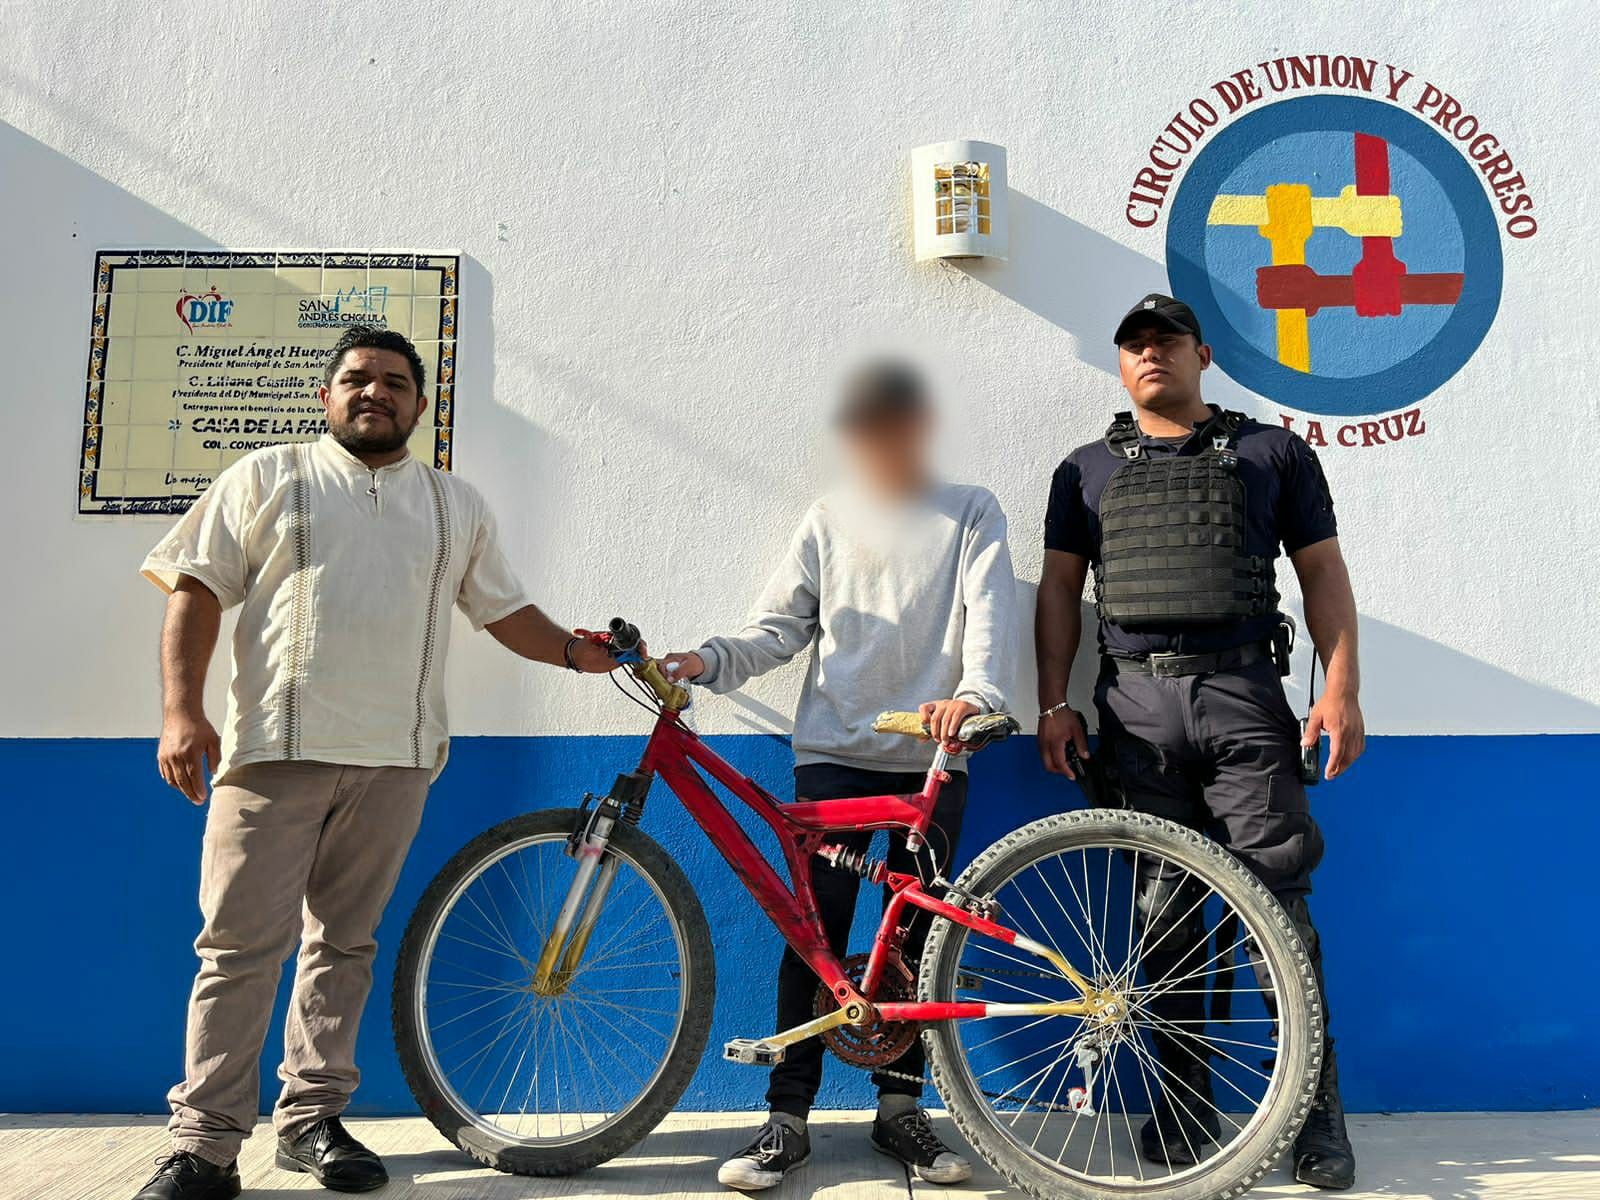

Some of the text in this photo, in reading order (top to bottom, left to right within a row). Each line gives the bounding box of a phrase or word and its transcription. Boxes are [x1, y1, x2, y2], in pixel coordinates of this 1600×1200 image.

[1125, 54, 1538, 240] CIRCULO DE UNION Y PROGRESO
[189, 300, 234, 323] DIF
[298, 299, 331, 312] SAN
[176, 345, 192, 358] C.
[194, 345, 244, 360] Miguel
[245, 342, 286, 359] Ángel
[178, 359, 224, 369] Presidente
[226, 359, 271, 370] Municipal
[272, 360, 282, 369] de
[284, 360, 301, 369] San
[188, 375, 204, 388] C.
[206, 375, 253, 388] Liliana
[256, 375, 305, 389] Castillo
[172, 390, 217, 399] Presidenta
[219, 390, 232, 399] del
[233, 390, 248, 400] Dif
[249, 390, 292, 401] Municipal
[293, 391, 310, 400] San
[183, 403, 219, 413] Entregan
[219, 404, 238, 413] para
[239, 404, 248, 412] el
[248, 404, 285, 413] beneficio
[286, 405, 296, 414] de
[297, 405, 305, 414] la
[191, 417, 240, 434] CASA
[243, 418, 270, 434] DE
[271, 419, 293, 435] LA
[1337, 408, 1426, 447] CRUZ
[180, 473, 212, 489] mejor
